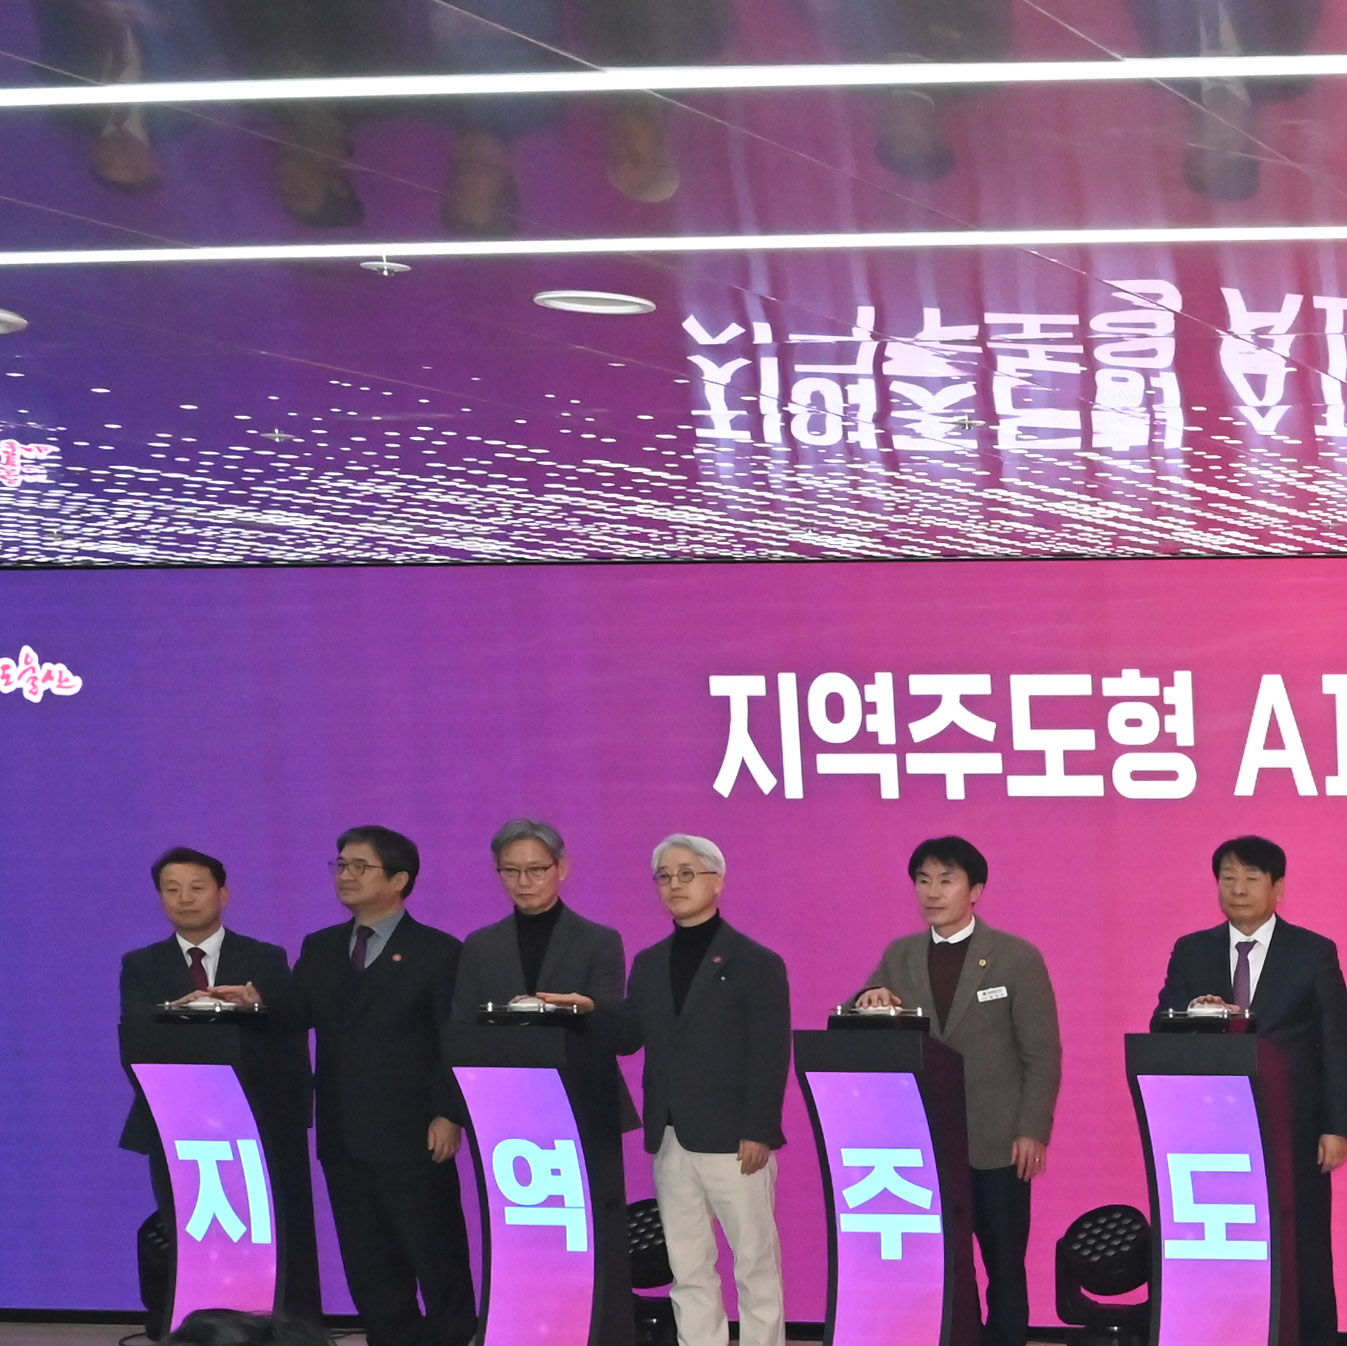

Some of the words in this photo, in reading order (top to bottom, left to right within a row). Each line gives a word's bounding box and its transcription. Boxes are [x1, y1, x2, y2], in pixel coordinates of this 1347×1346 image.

[708, 668, 1198, 800] 지역주도형
[174, 1139, 272, 1244] 지
[492, 1138, 588, 1252] 역
[839, 1148, 942, 1260] 주
[1164, 1153, 1268, 1261] 도
